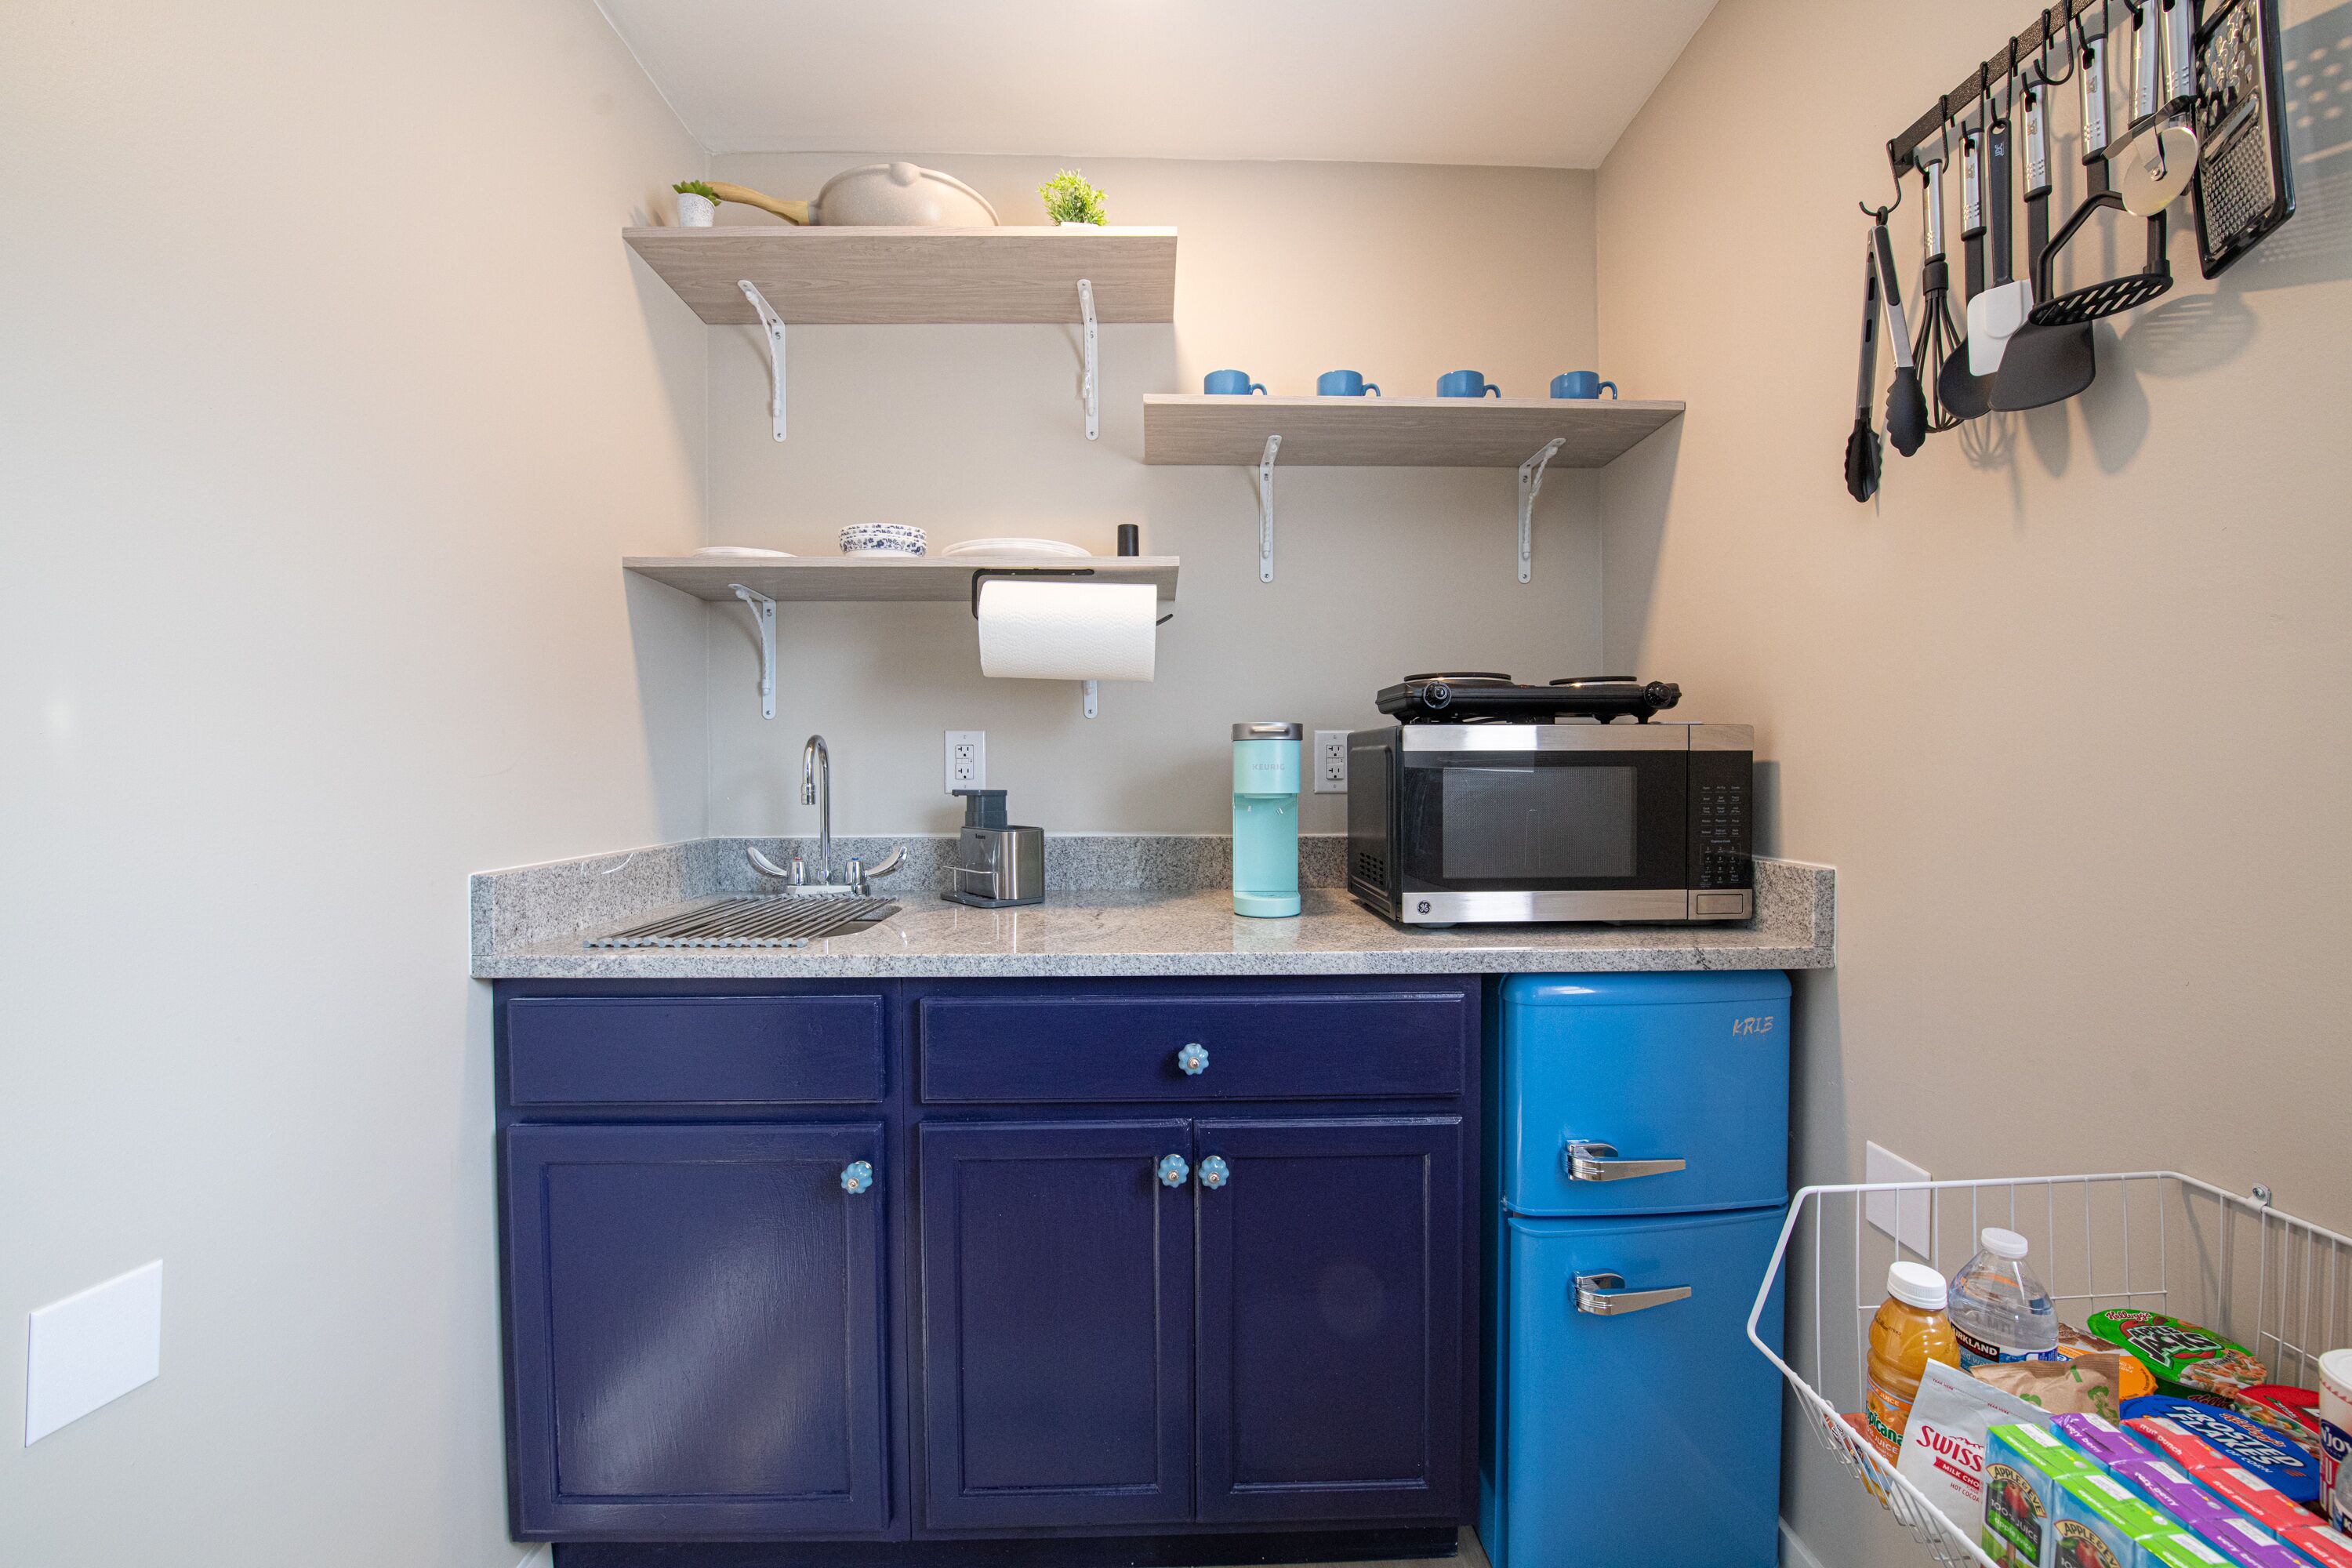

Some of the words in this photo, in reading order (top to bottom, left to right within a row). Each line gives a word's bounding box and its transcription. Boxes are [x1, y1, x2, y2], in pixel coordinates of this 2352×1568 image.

[2105, 1310, 2152, 1322] Kellogg's
[2129, 1325, 2180, 1338] APPLE
[2129, 1332, 2221, 1367] JACKS
[1879, 1392, 1900, 1406] JUICE
[1875, 1436, 1899, 1455] JUICE
[1916, 1425, 1983, 1472] SWISS
[2165, 1413, 2281, 1467] FLAKES
[2171, 1406, 2306, 1468] FROSTED
[2225, 1449, 2242, 1457] OF
[2241, 1457, 2274, 1473] CORN
[1942, 1464, 1962, 1479] MILK
[1962, 1475, 1980, 1487] CHO
[1950, 1483, 1962, 1491] HOT
[1962, 1490, 1980, 1503] COCOA
[1994, 1466, 2022, 1484] APPLE
[2027, 1490, 2042, 1513] EVE
[2016, 1519, 2038, 1544] JUICE
[2063, 1523, 2096, 1544] APPLE
[2103, 1549, 2118, 1568] EV
